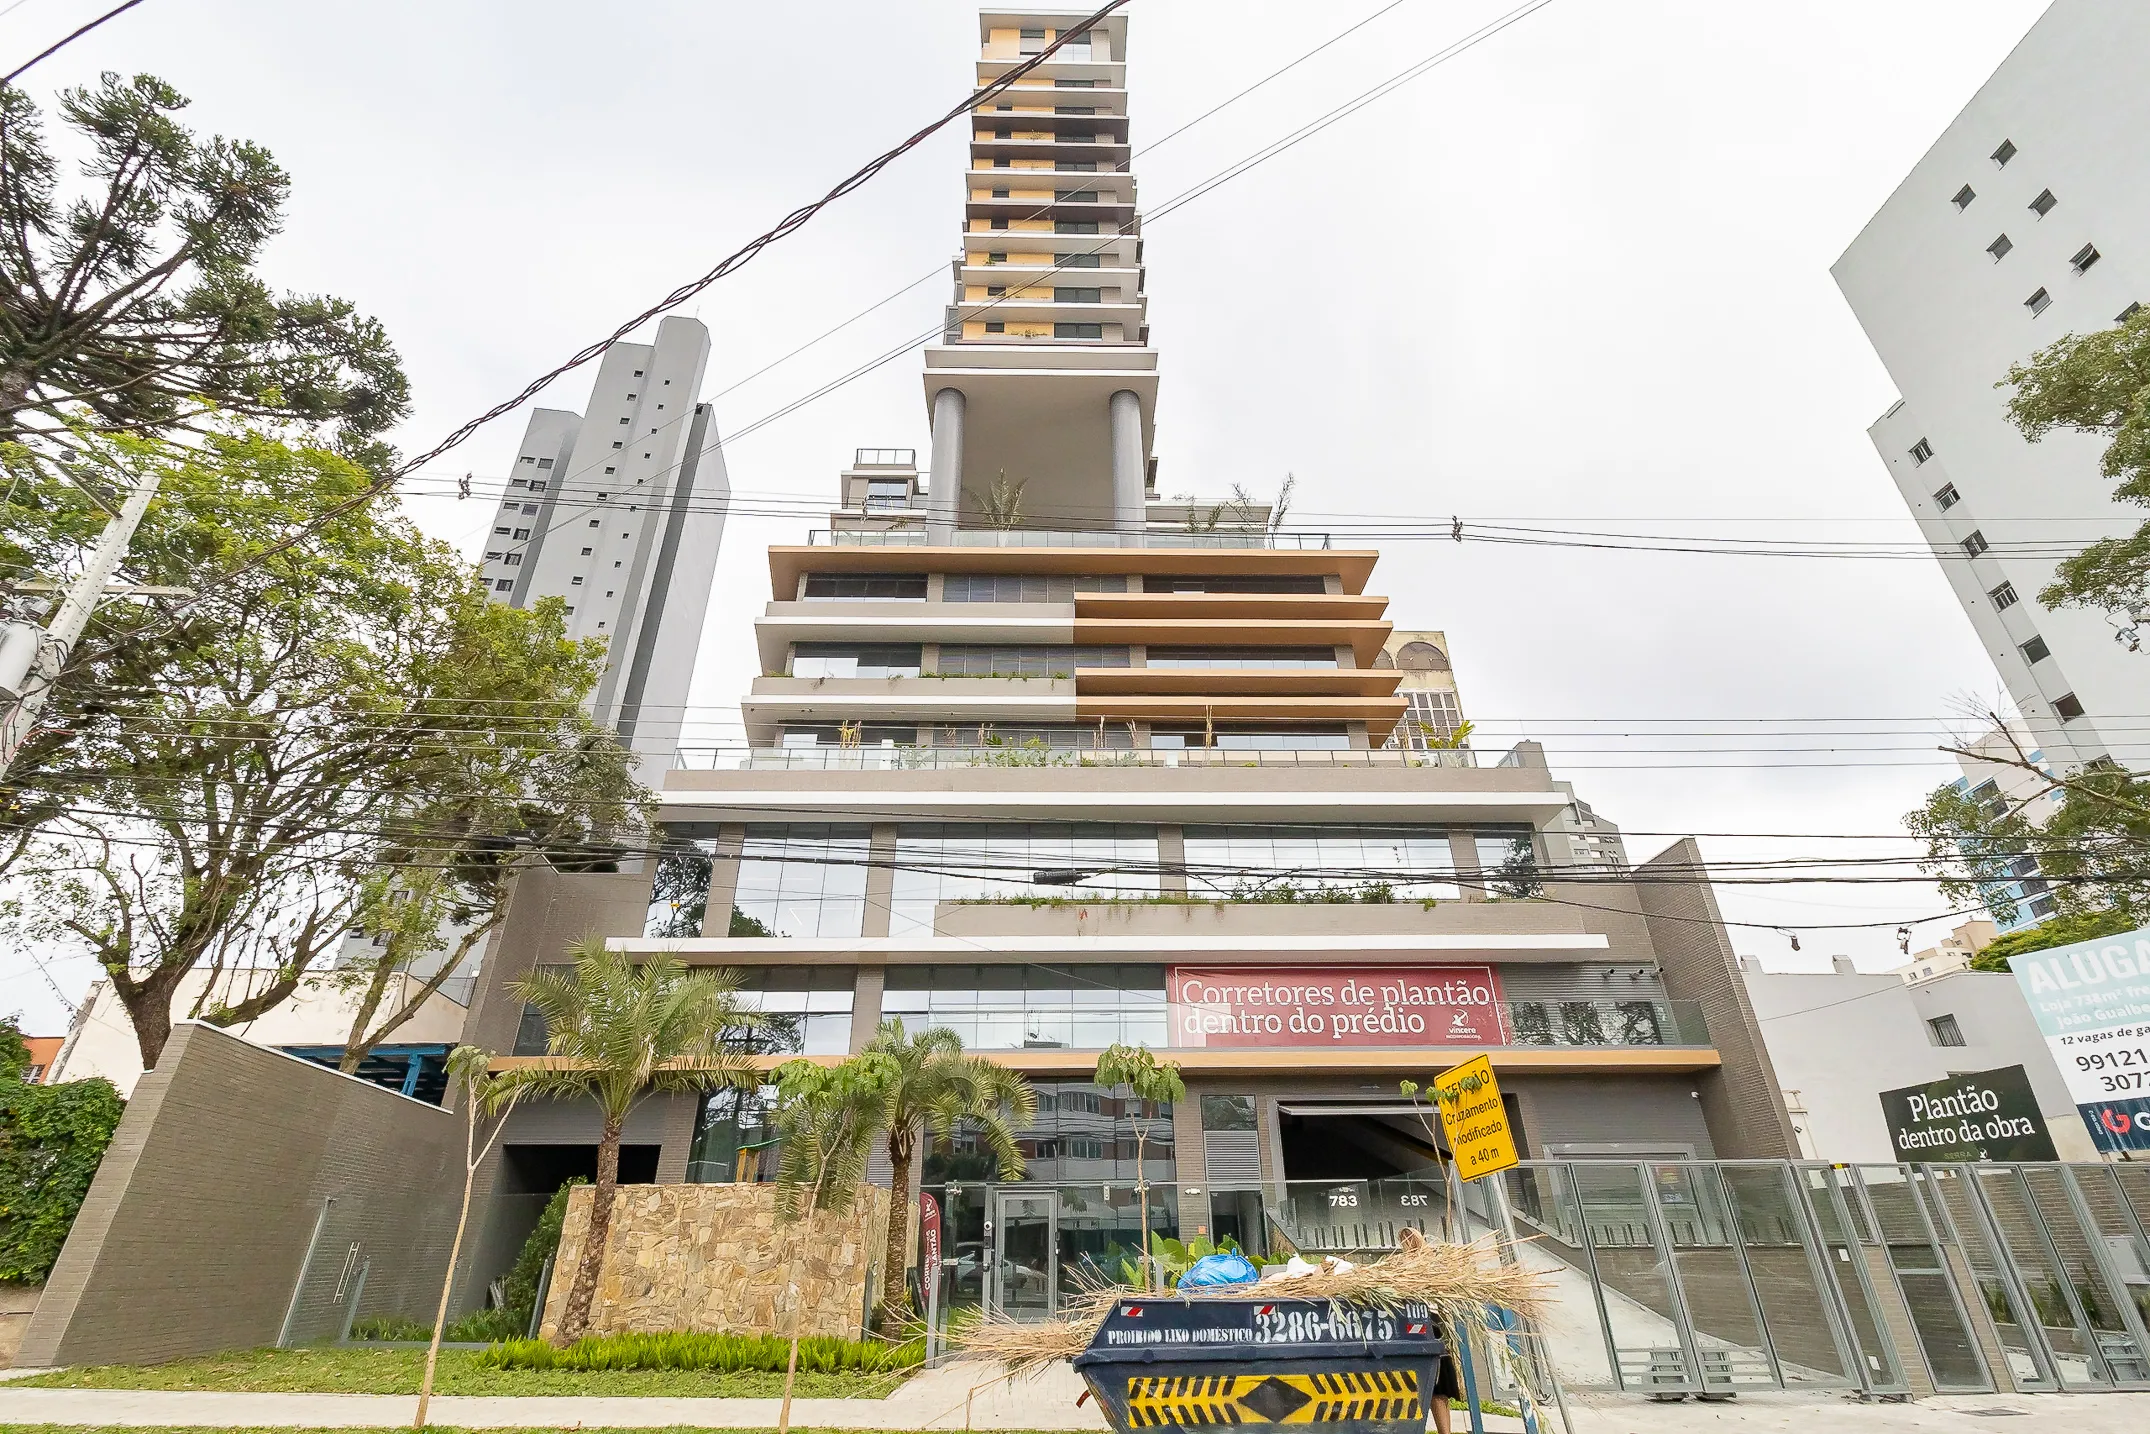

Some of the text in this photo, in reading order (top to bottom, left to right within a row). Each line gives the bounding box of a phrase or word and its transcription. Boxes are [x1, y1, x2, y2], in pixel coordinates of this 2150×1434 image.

[1182, 979, 1490, 1010] Corretores de plantão
[2038, 998, 2072, 1015] Loja
[1184, 1006, 1425, 1039] dentro do prédio
[2056, 1012, 2092, 1029] João
[2061, 1036, 2074, 1046] 12
[2077, 1031, 2114, 1044] vagas
[2116, 1028, 2132, 1038] de
[1446, 1097, 1498, 1126] Cruzamento
[1907, 1085, 1999, 1123] Plantão
[1899, 1115, 2036, 1150] dentro da obra
[1470, 1147, 1500, 1166] a 40 m
[1329, 1195, 1358, 1207] 783
[930, 1229, 938, 1268] LANTÃO
[1107, 1329, 1163, 1345] PROIBIDO
[1164, 1328, 1190, 1343] LIXO
[1255, 1311, 1393, 1344] 3286-6675
